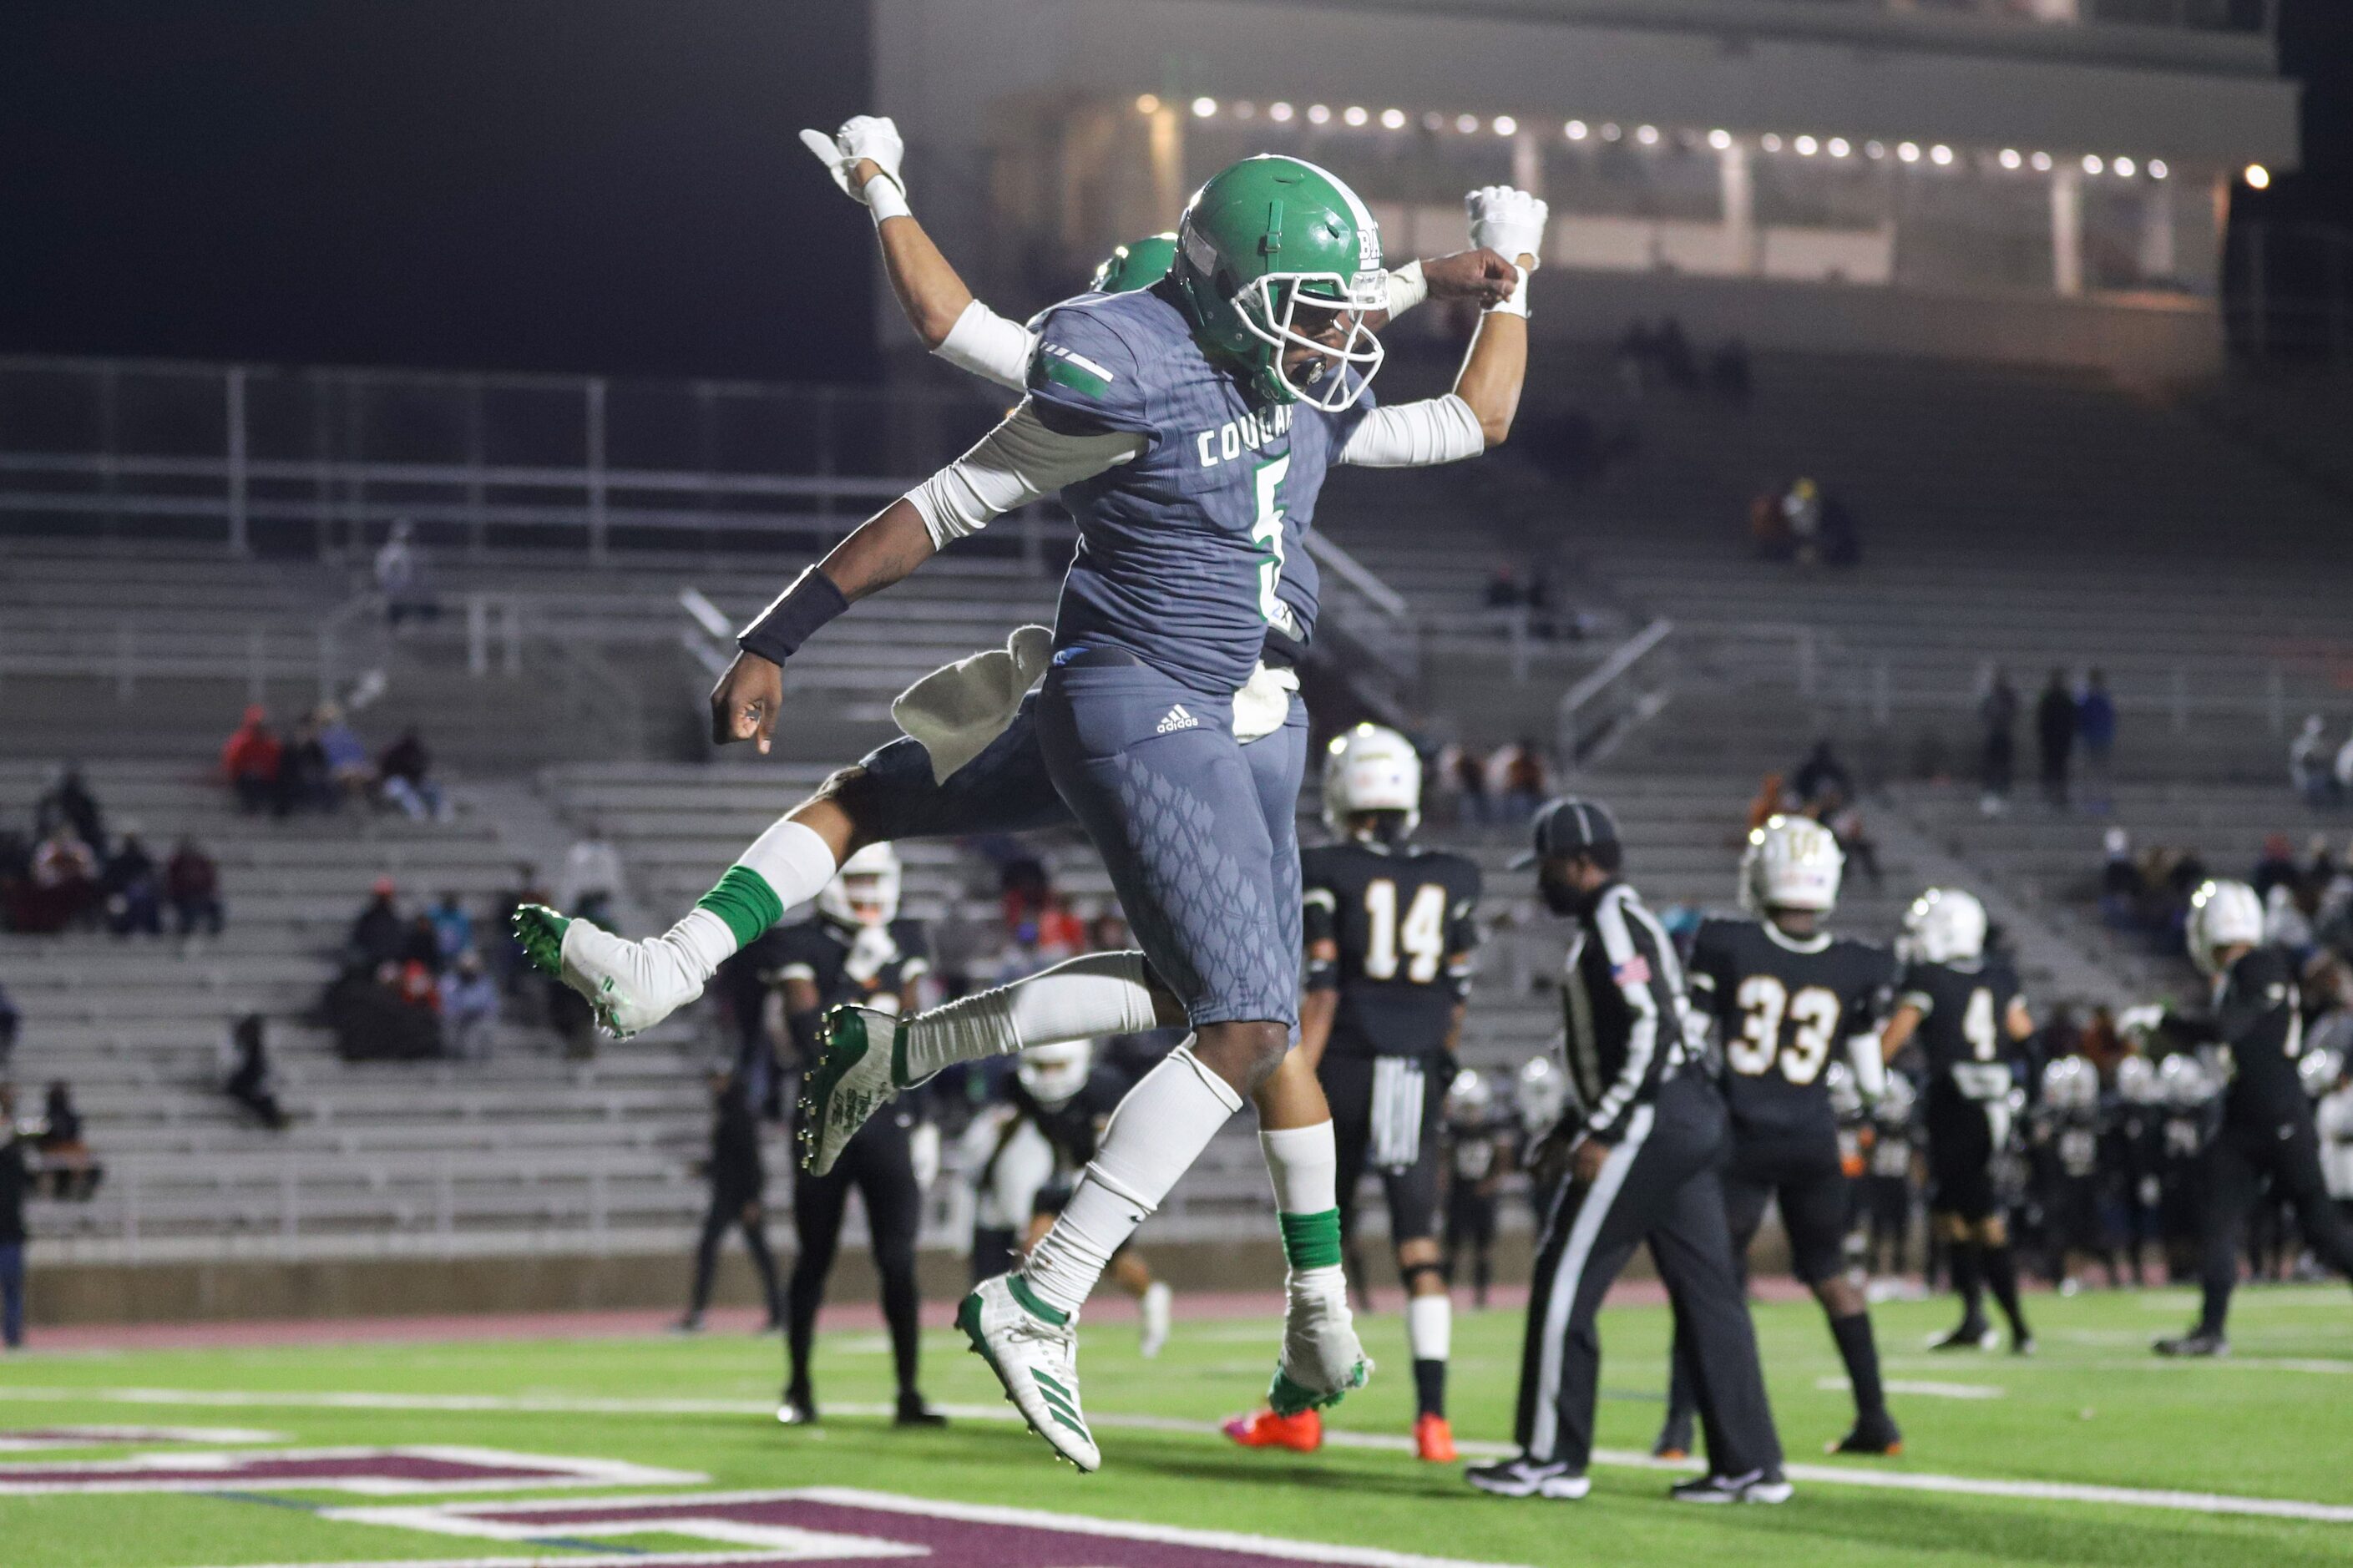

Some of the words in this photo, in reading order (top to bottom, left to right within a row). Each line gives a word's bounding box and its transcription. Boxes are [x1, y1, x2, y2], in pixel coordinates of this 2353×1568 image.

[1156, 717, 1198, 734] adidas
[1365, 879, 1446, 984] 14
[1728, 975, 1839, 1085] 33
[1964, 987, 1996, 1061] 4
